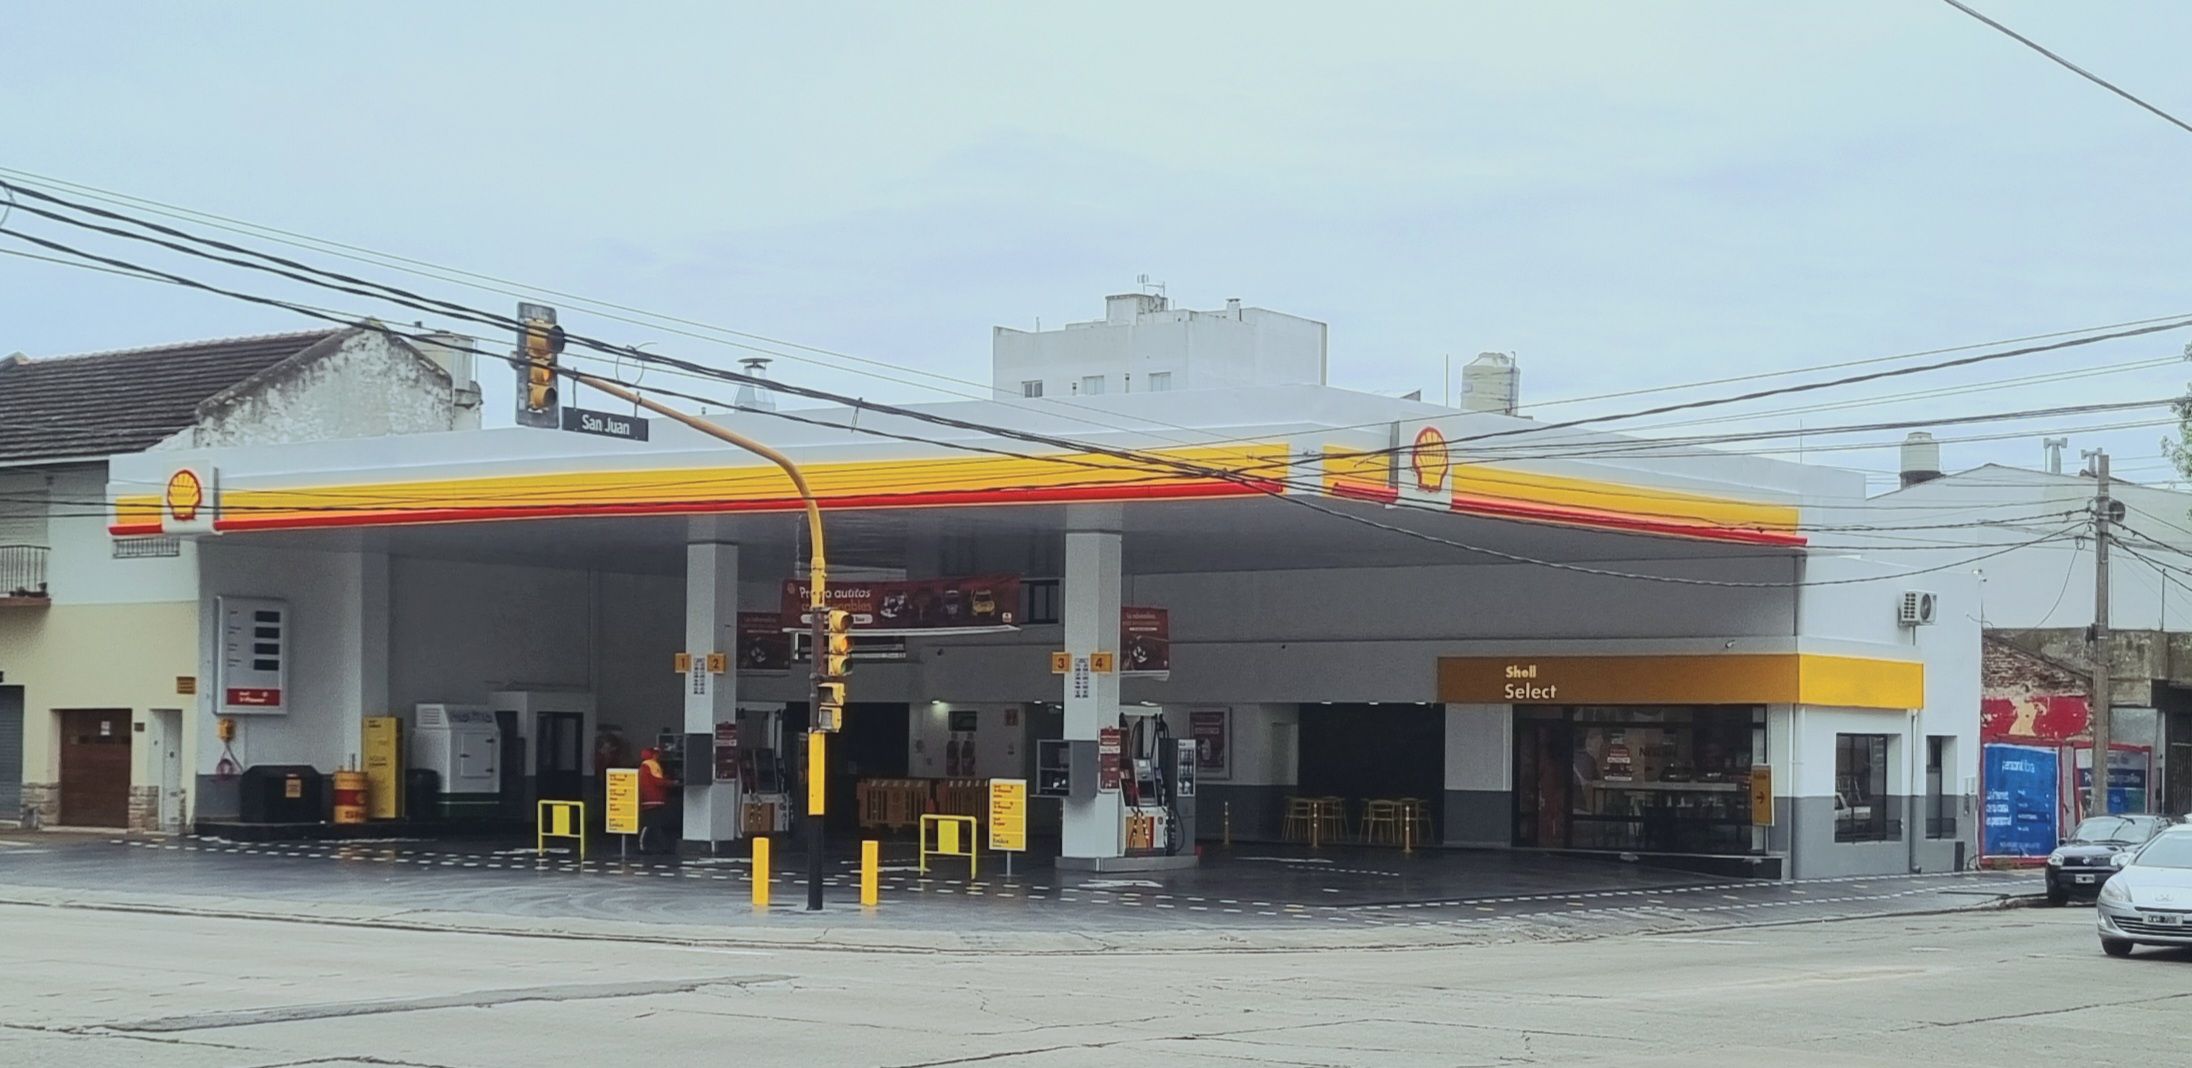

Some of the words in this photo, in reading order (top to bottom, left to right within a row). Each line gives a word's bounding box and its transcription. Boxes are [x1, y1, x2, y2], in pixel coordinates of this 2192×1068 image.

[581, 413, 603, 432] San
[604, 417, 630, 435] Juan
[834, 588, 871, 598] autitos
[680, 657, 686, 669] 1
[712, 658, 720, 669] 2
[1057, 657, 1066, 669] 3
[1095, 657, 1103, 669] 4
[1505, 664, 1537, 678] Shell
[1504, 681, 1557, 699] Select
